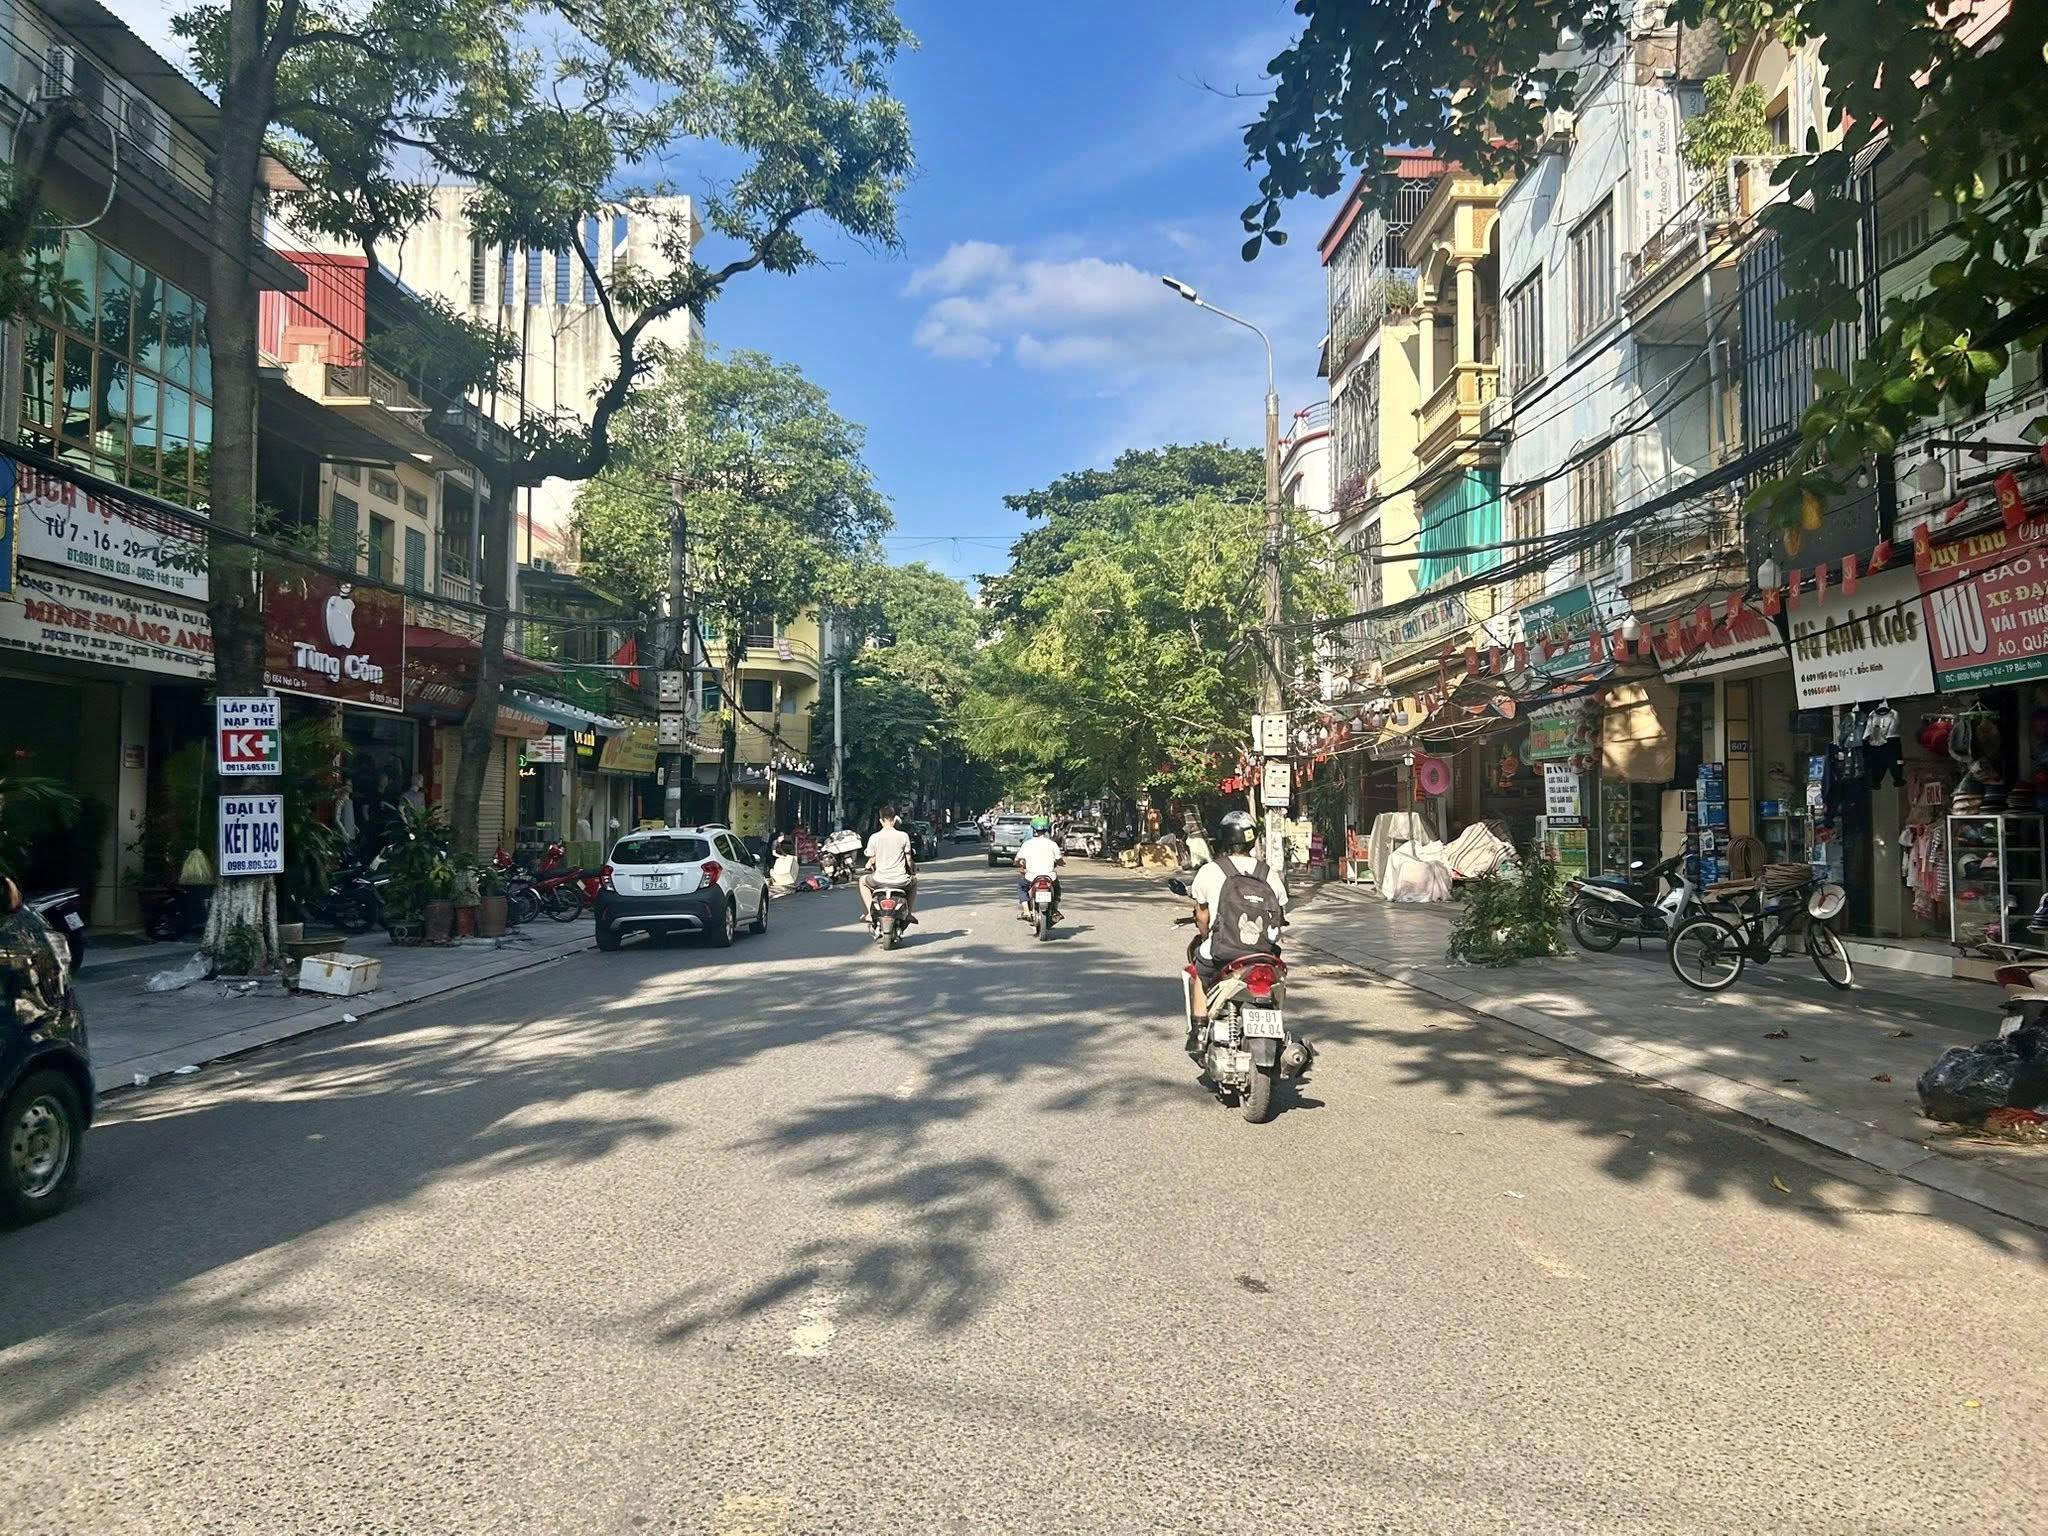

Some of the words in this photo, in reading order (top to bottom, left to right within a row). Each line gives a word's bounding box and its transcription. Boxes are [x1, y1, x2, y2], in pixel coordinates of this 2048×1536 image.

[46, 514, 66, 538] TỪ
[70, 523, 79, 542] 7
[94, 530, 110, 552] 16
[18, 574, 53, 593] ÔNG
[56, 584, 76, 598] TY
[77, 589, 113, 608] TNHH
[116, 598, 142, 615] VẬN
[164, 607, 180, 621] VÀ
[182, 613, 197, 625] DU
[1986, 589, 2012, 608] XE
[2015, 580, 2048, 600] ĐẠ
[24, 598, 91, 632] MINH
[1825, 608, 1866, 657] Anh
[1867, 599, 1917, 648] Kids
[1991, 609, 2017, 633] VẢI
[224, 717, 249, 729] NẠP
[229, 733, 276, 758] K+
[225, 802, 254, 817] ĐẠI
[259, 799, 278, 815] LÝ
[225, 818, 249, 854] KÉT
[253, 822, 279, 858] BẠC
